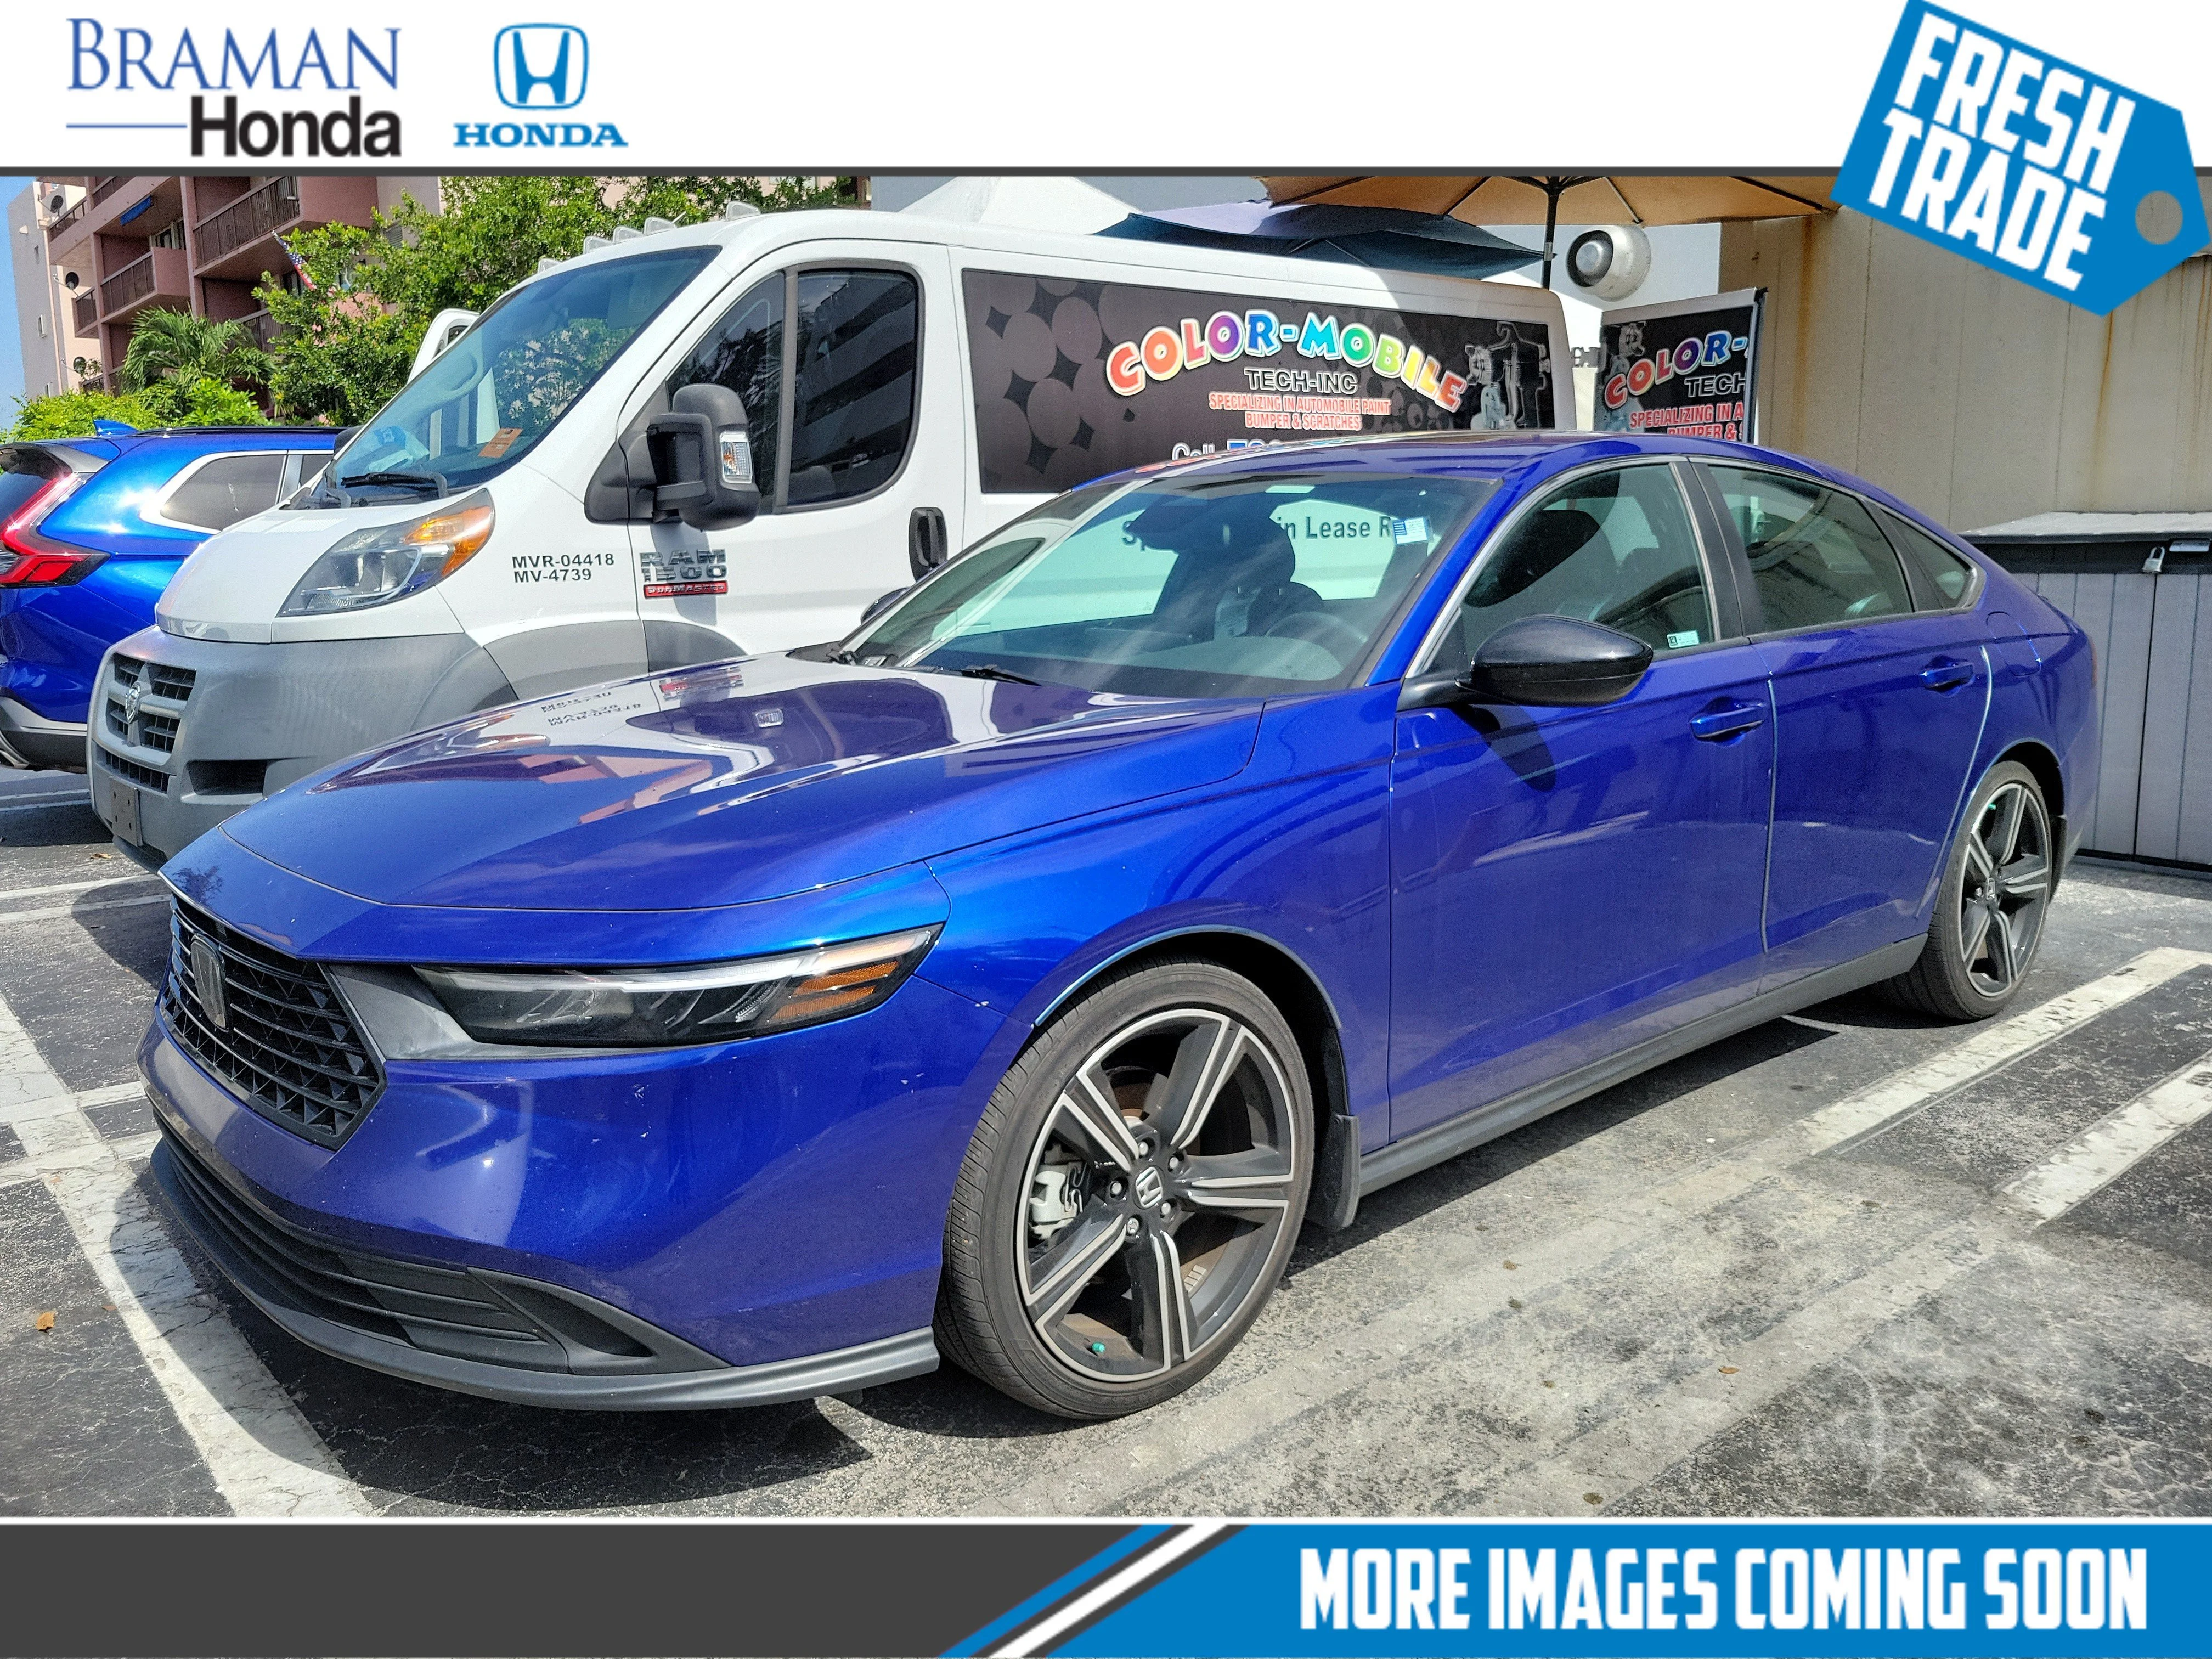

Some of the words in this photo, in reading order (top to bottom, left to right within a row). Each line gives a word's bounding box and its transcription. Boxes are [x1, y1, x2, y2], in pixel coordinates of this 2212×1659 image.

[1107, 309, 1468, 412] COLOR-MOBILE
[1244, 368, 1358, 394] TECH-INC
[1209, 392, 1282, 411] SPECIALIZING
[1283, 394, 1296, 412] IN
[1296, 396, 1361, 414] AUTOMOBILE
[1361, 398, 1391, 415] PAINT
[1245, 411, 1292, 429] BUMPER
[1292, 413, 1302, 430] &
[1302, 414, 1363, 431] SCRATCHES
[1629, 404, 1714, 428] SPECIALIZING
[1716, 403, 1733, 422] IN
[1306, 516, 1370, 539] Lease
[512, 554, 614, 568] MVR-04418
[640, 549, 726, 567] RAM
[514, 568, 591, 583] MV-4739
[641, 565, 727, 582] 1500
